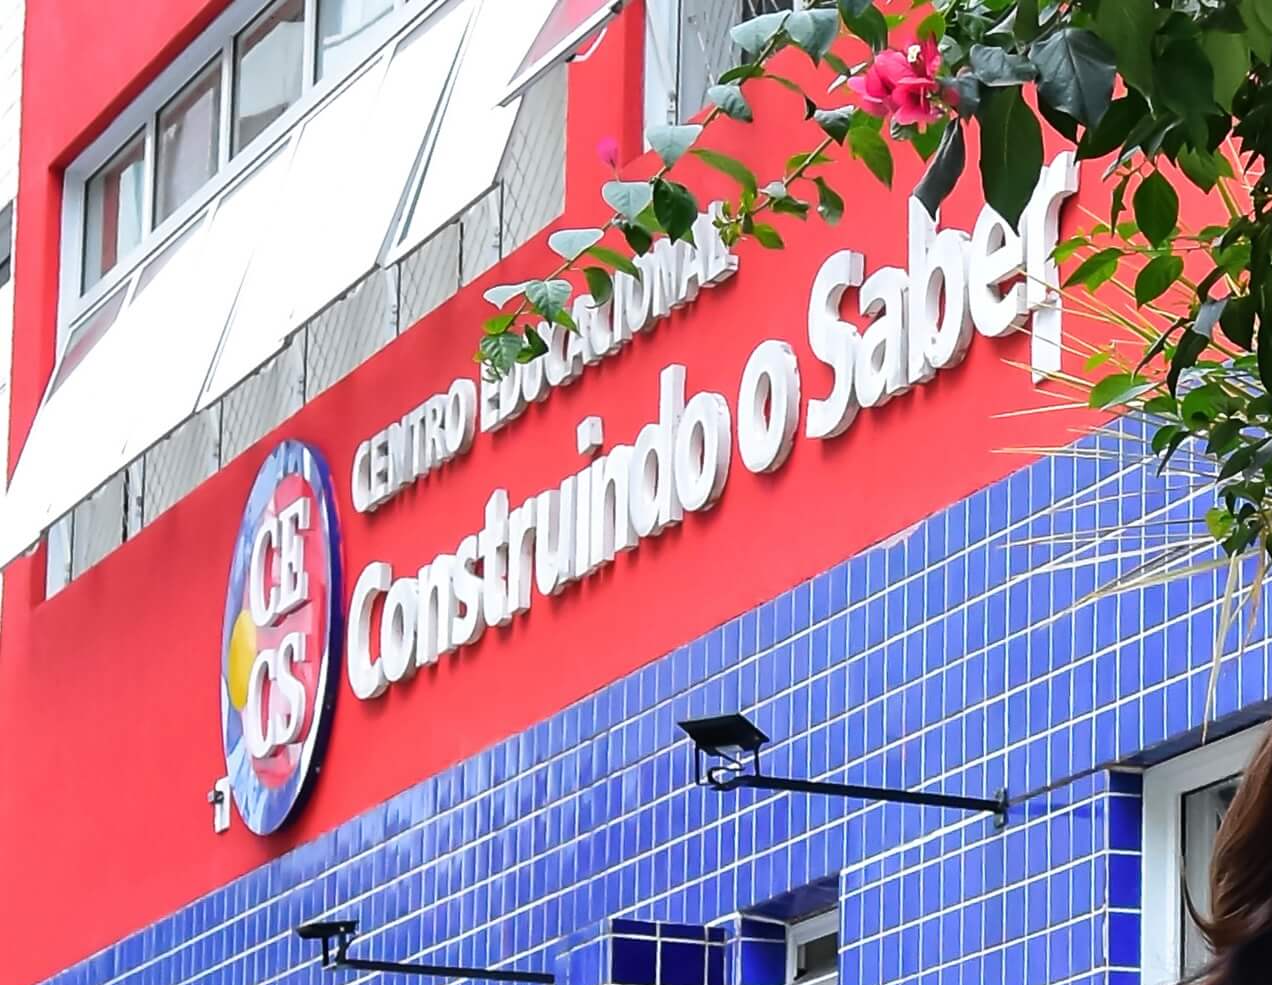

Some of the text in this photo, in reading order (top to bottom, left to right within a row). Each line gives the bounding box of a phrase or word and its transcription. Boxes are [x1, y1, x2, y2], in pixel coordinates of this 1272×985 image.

[347, 363, 732, 700] Construindo
[806, 150, 1080, 439] Saber
[352, 378, 477, 513] CENTRO
[249, 497, 311, 629] CE
[246, 631, 306, 760] CS
